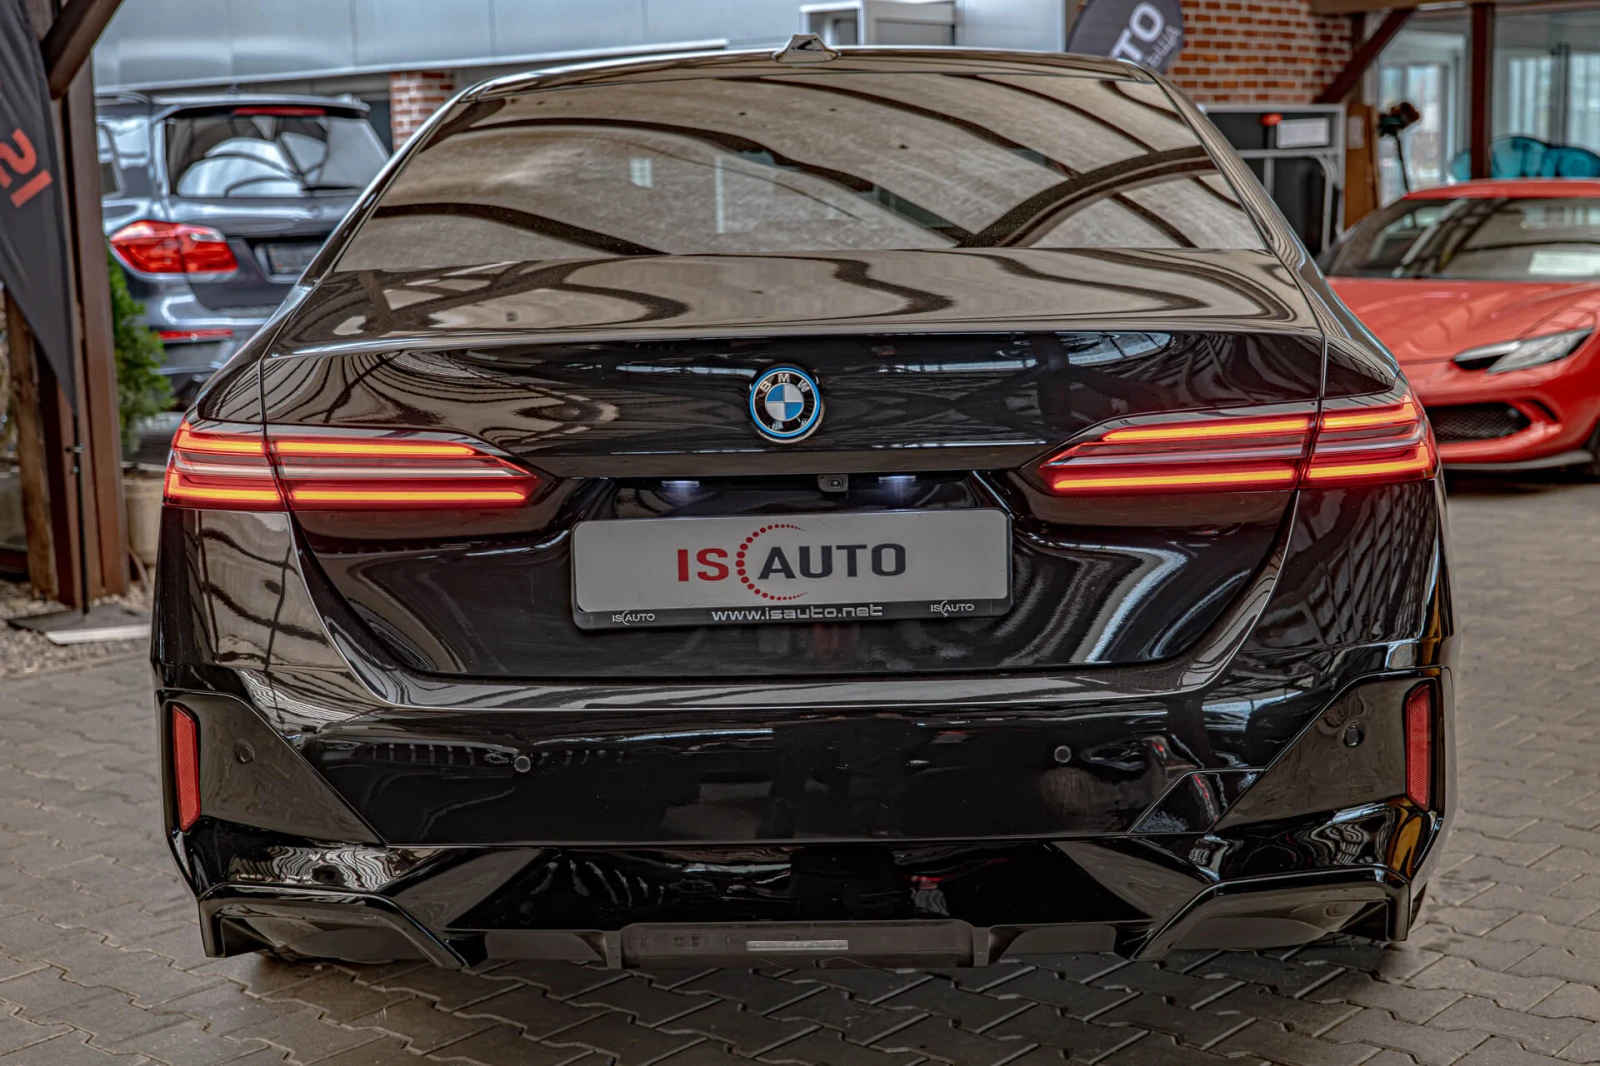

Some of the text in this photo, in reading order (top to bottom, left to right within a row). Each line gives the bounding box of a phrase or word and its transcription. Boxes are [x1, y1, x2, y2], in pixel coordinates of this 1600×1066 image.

[1109, 1, 1166, 63] TO
[759, 373, 811, 393] BMW
[711, 604, 883, 622] www.isauto.net
